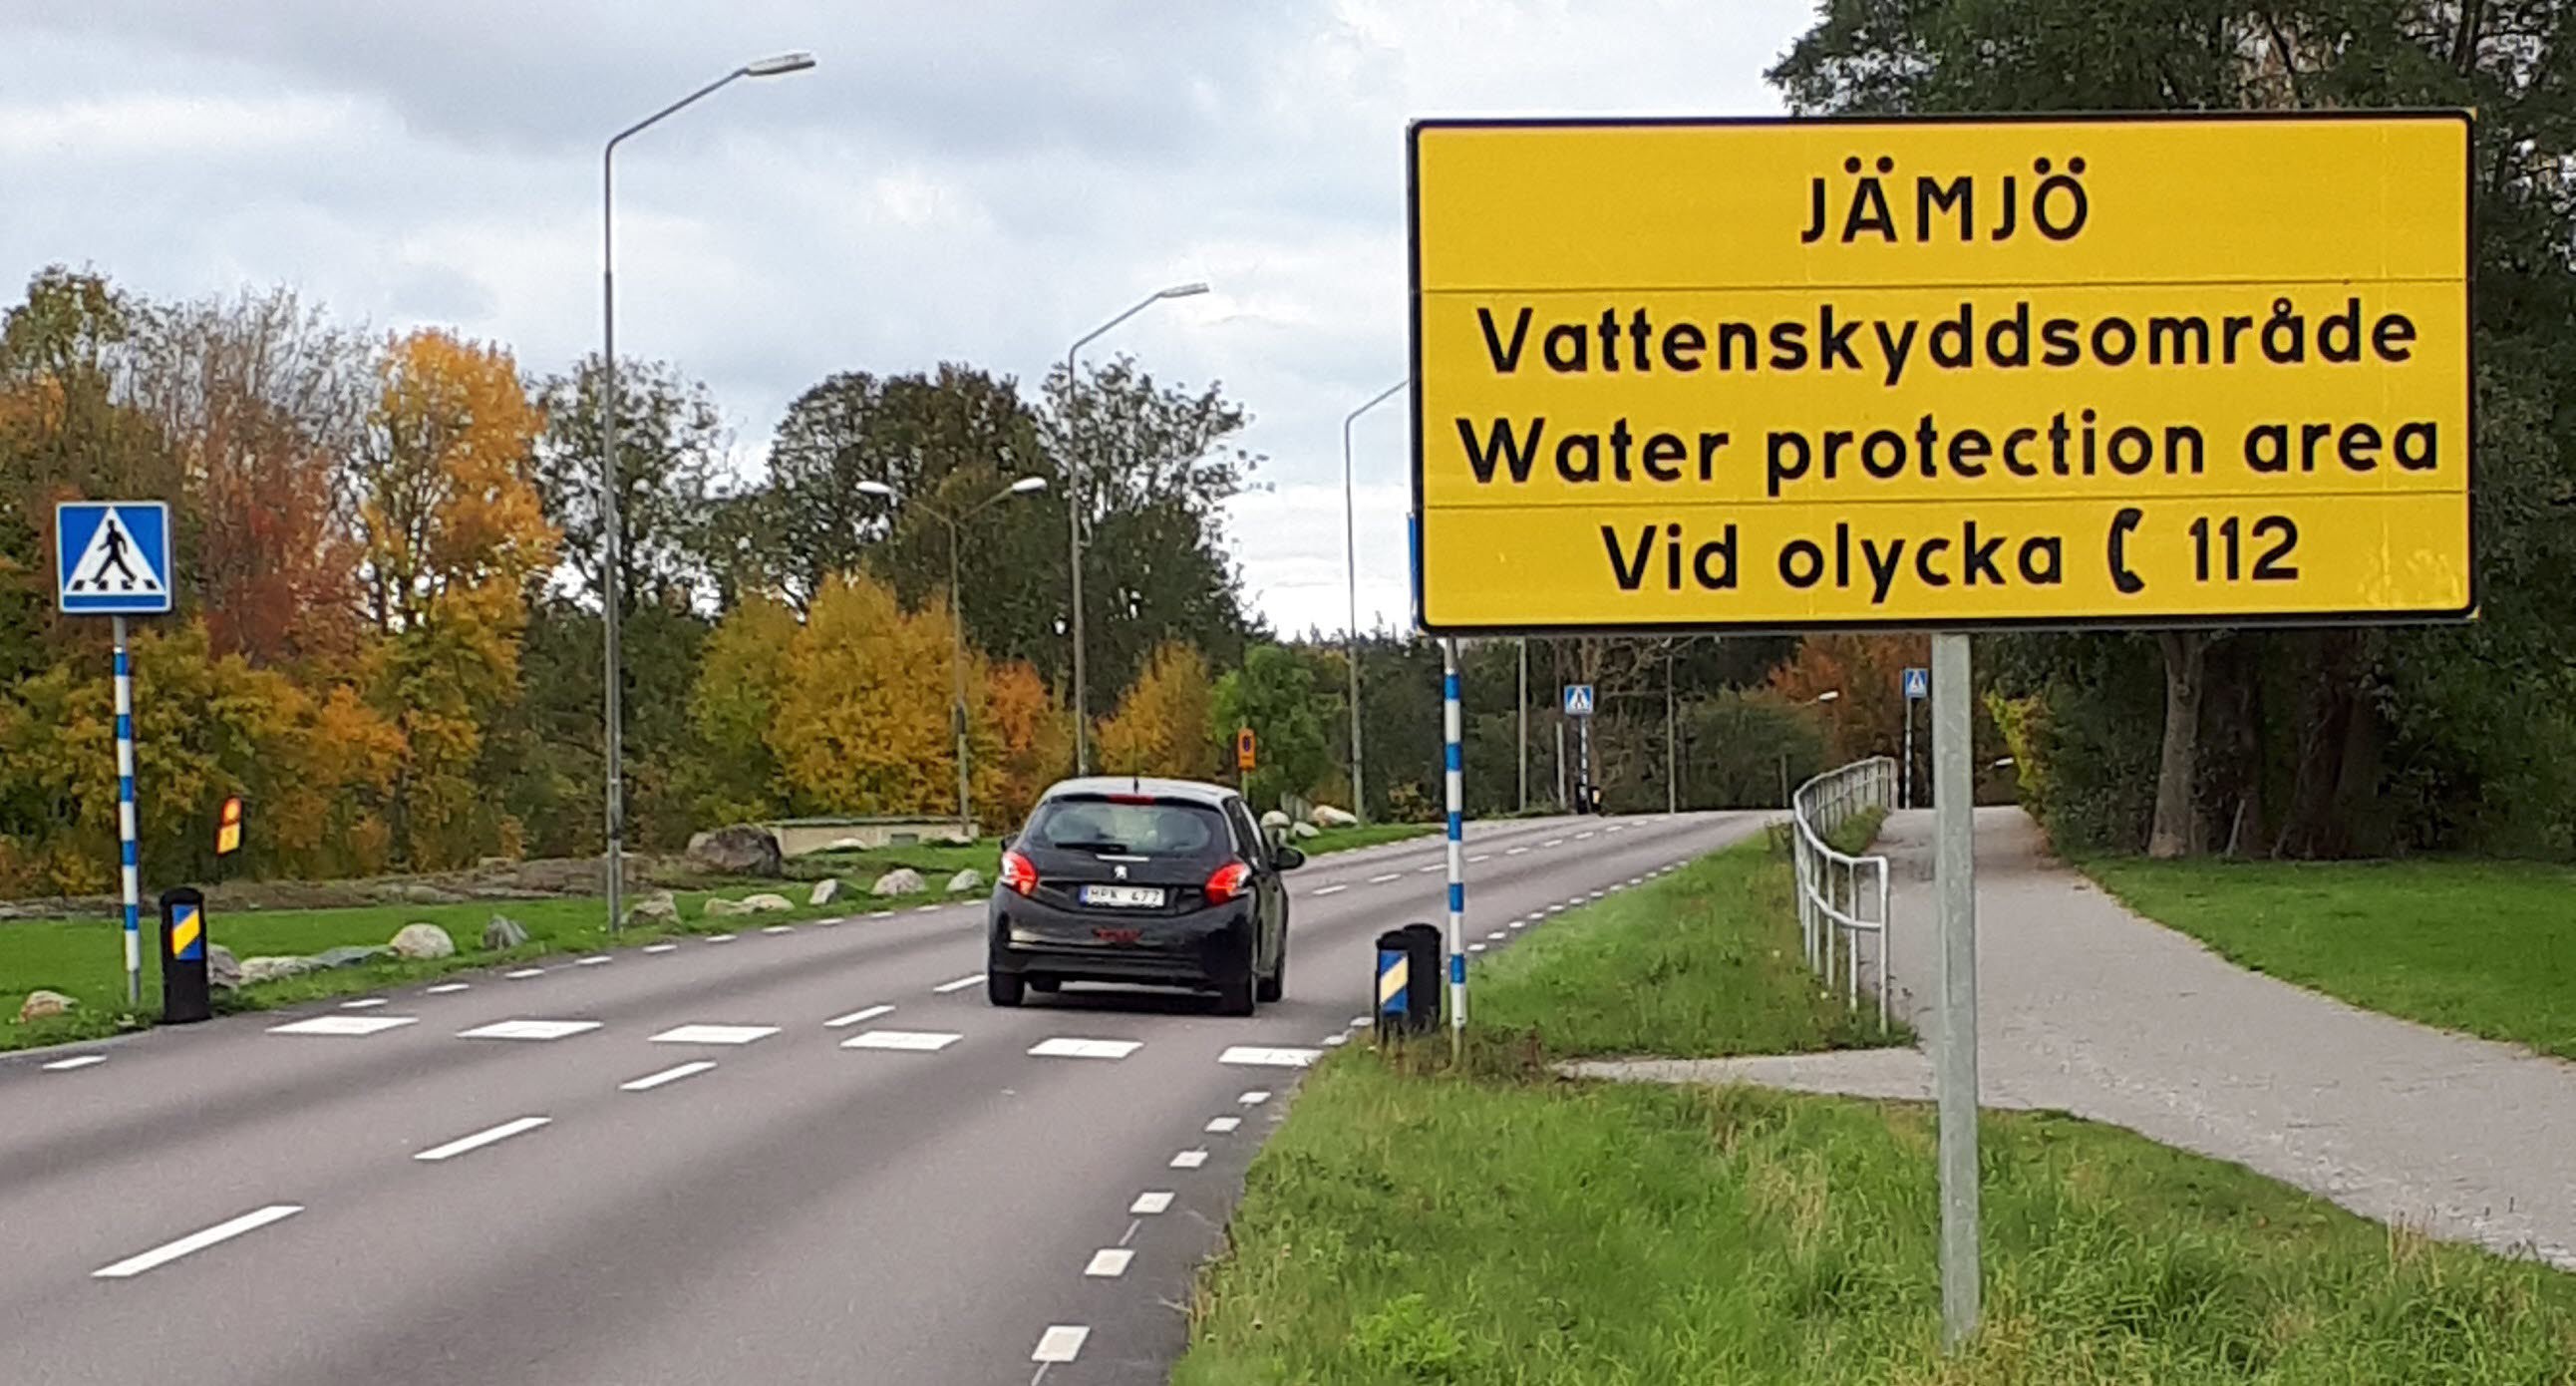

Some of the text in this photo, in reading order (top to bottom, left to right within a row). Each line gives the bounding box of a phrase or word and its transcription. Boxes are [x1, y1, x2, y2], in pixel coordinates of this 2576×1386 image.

[1801, 156, 2088, 243] JÄMJÖ
[1477, 297, 2416, 386] Vattenskyddsområde
[1455, 409, 2437, 498] Water protection area
[1601, 515, 2298, 604] Vid olycka 112
